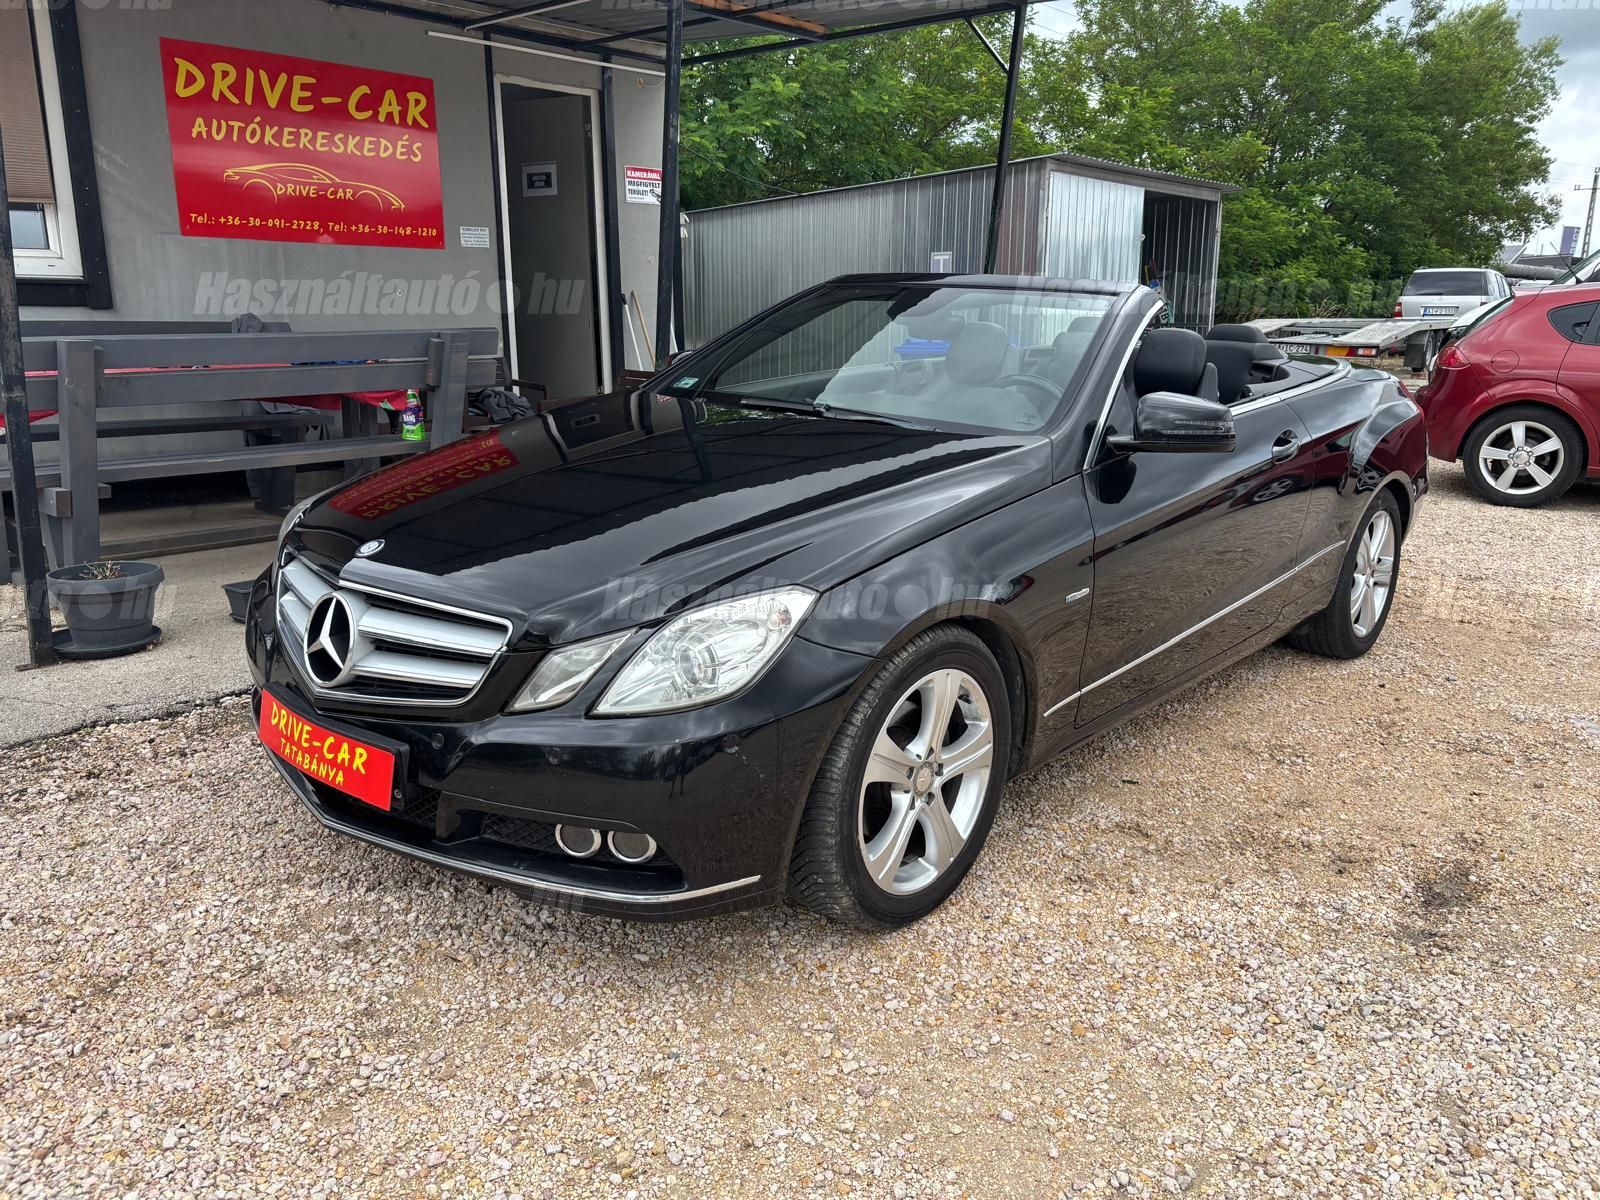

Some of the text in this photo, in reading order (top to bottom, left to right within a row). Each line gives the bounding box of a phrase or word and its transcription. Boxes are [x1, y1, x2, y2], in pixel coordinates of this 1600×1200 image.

[174, 57, 430, 128] DRIVE-CAR
[191, 116, 423, 163] AUTÓKERESKEDÉS
[627, 170, 660, 180] KAMERÁVAL
[627, 180, 661, 189] MEGFIGYELT
[276, 183, 354, 201] DRIVE-CAR
[628, 188, 648, 197] TERÜLET!
[190, 213, 437, 237] Tel.: +36-30-091-2728, Tel: +36-30-148-1210
[271, 702, 368, 775] DRIVE-CAR
[280, 737, 345, 787] TATABÁNYA
